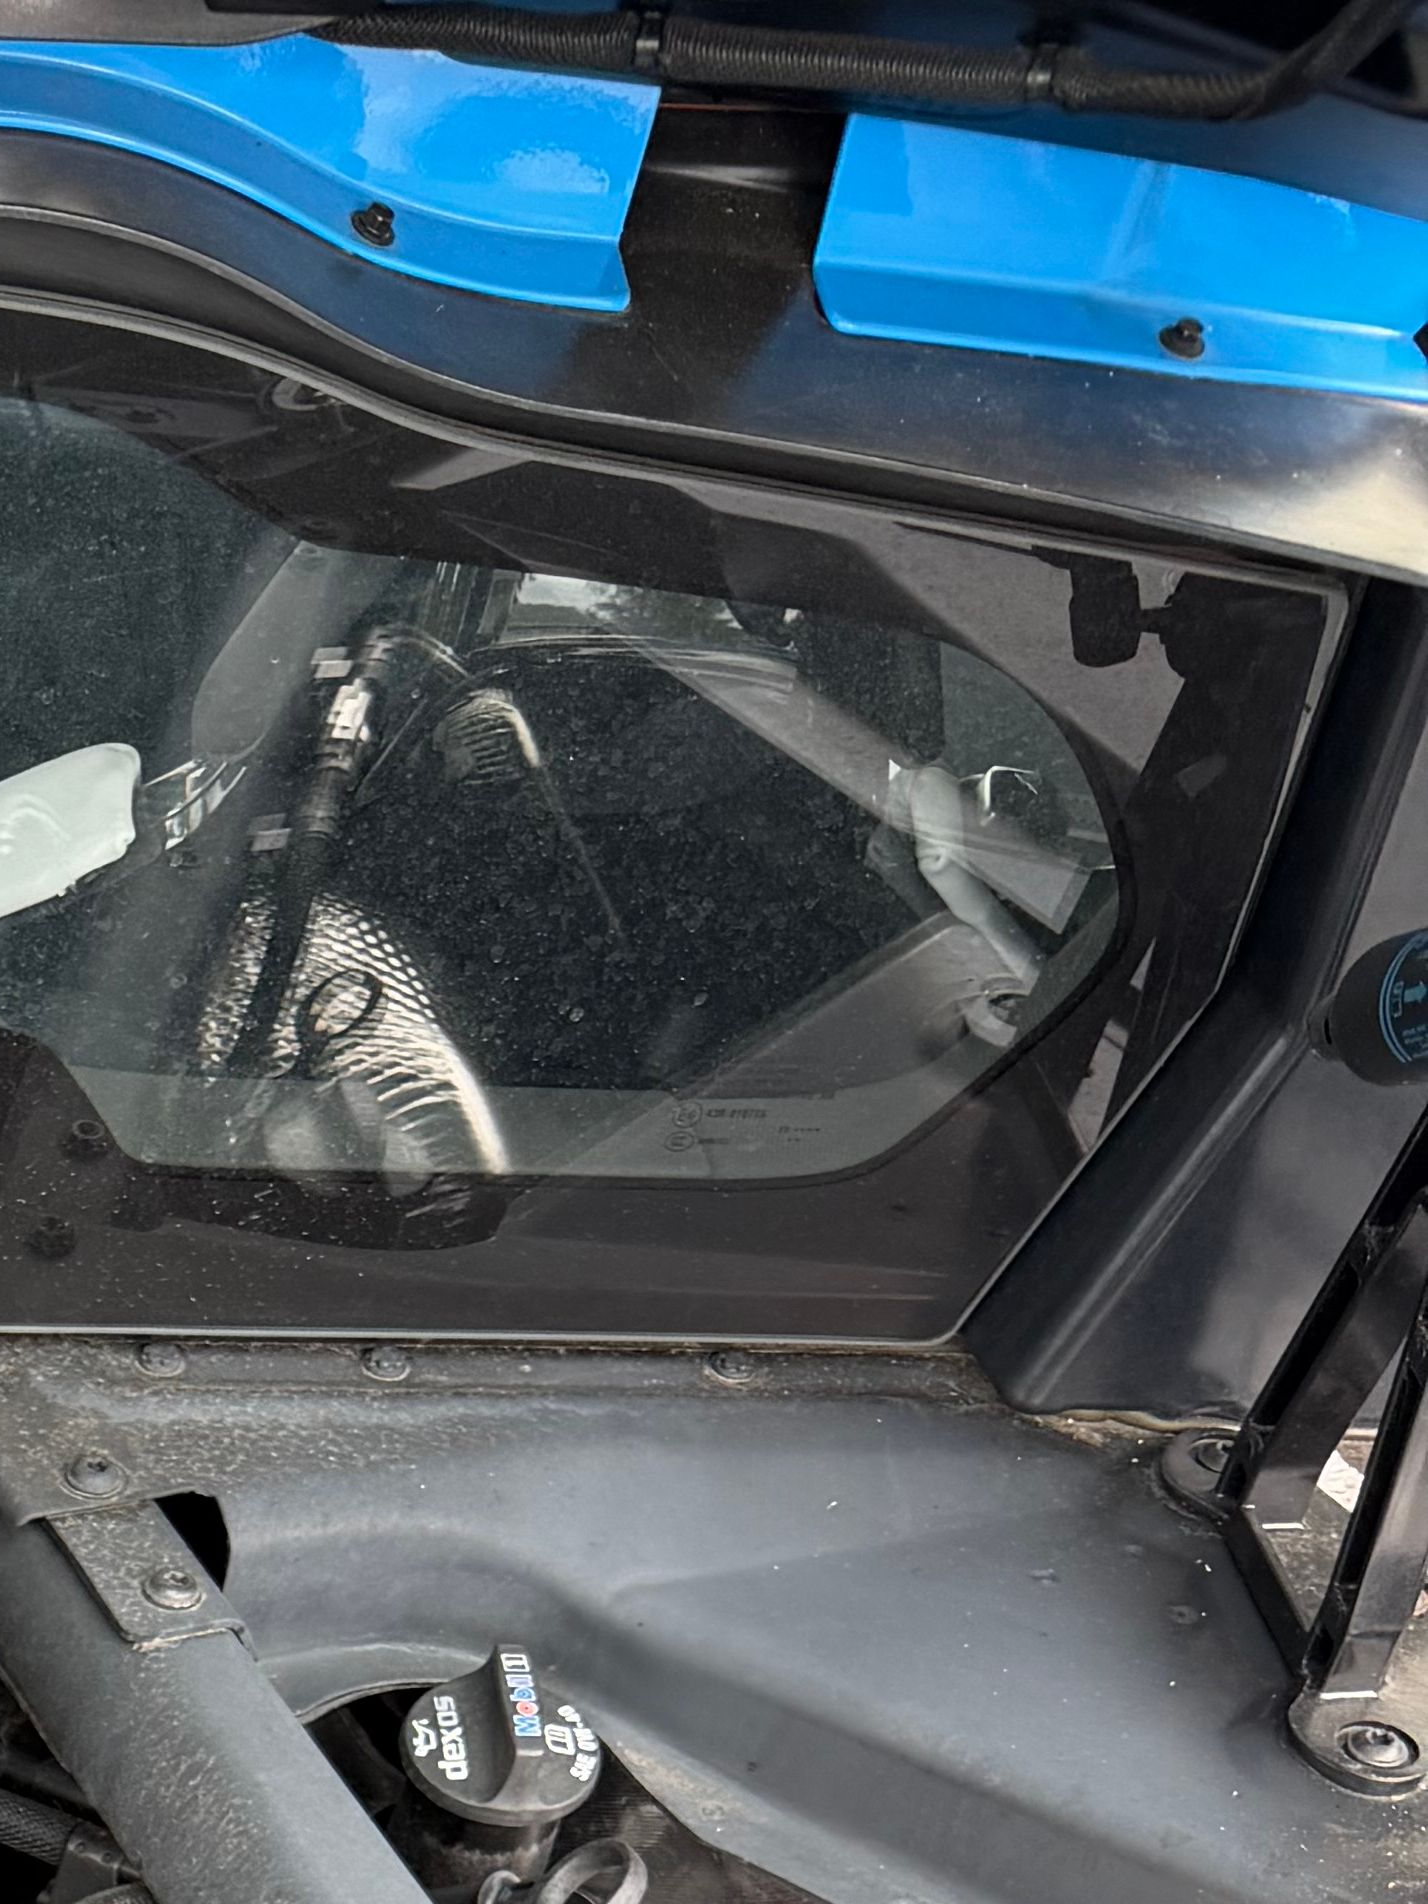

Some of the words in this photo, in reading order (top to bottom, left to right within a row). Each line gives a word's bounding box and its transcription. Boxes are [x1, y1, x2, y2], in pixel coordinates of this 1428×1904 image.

[505, 1674, 542, 1737] Mobil
[433, 1695, 469, 1781] dexos
[569, 1753, 596, 1782] SAE
